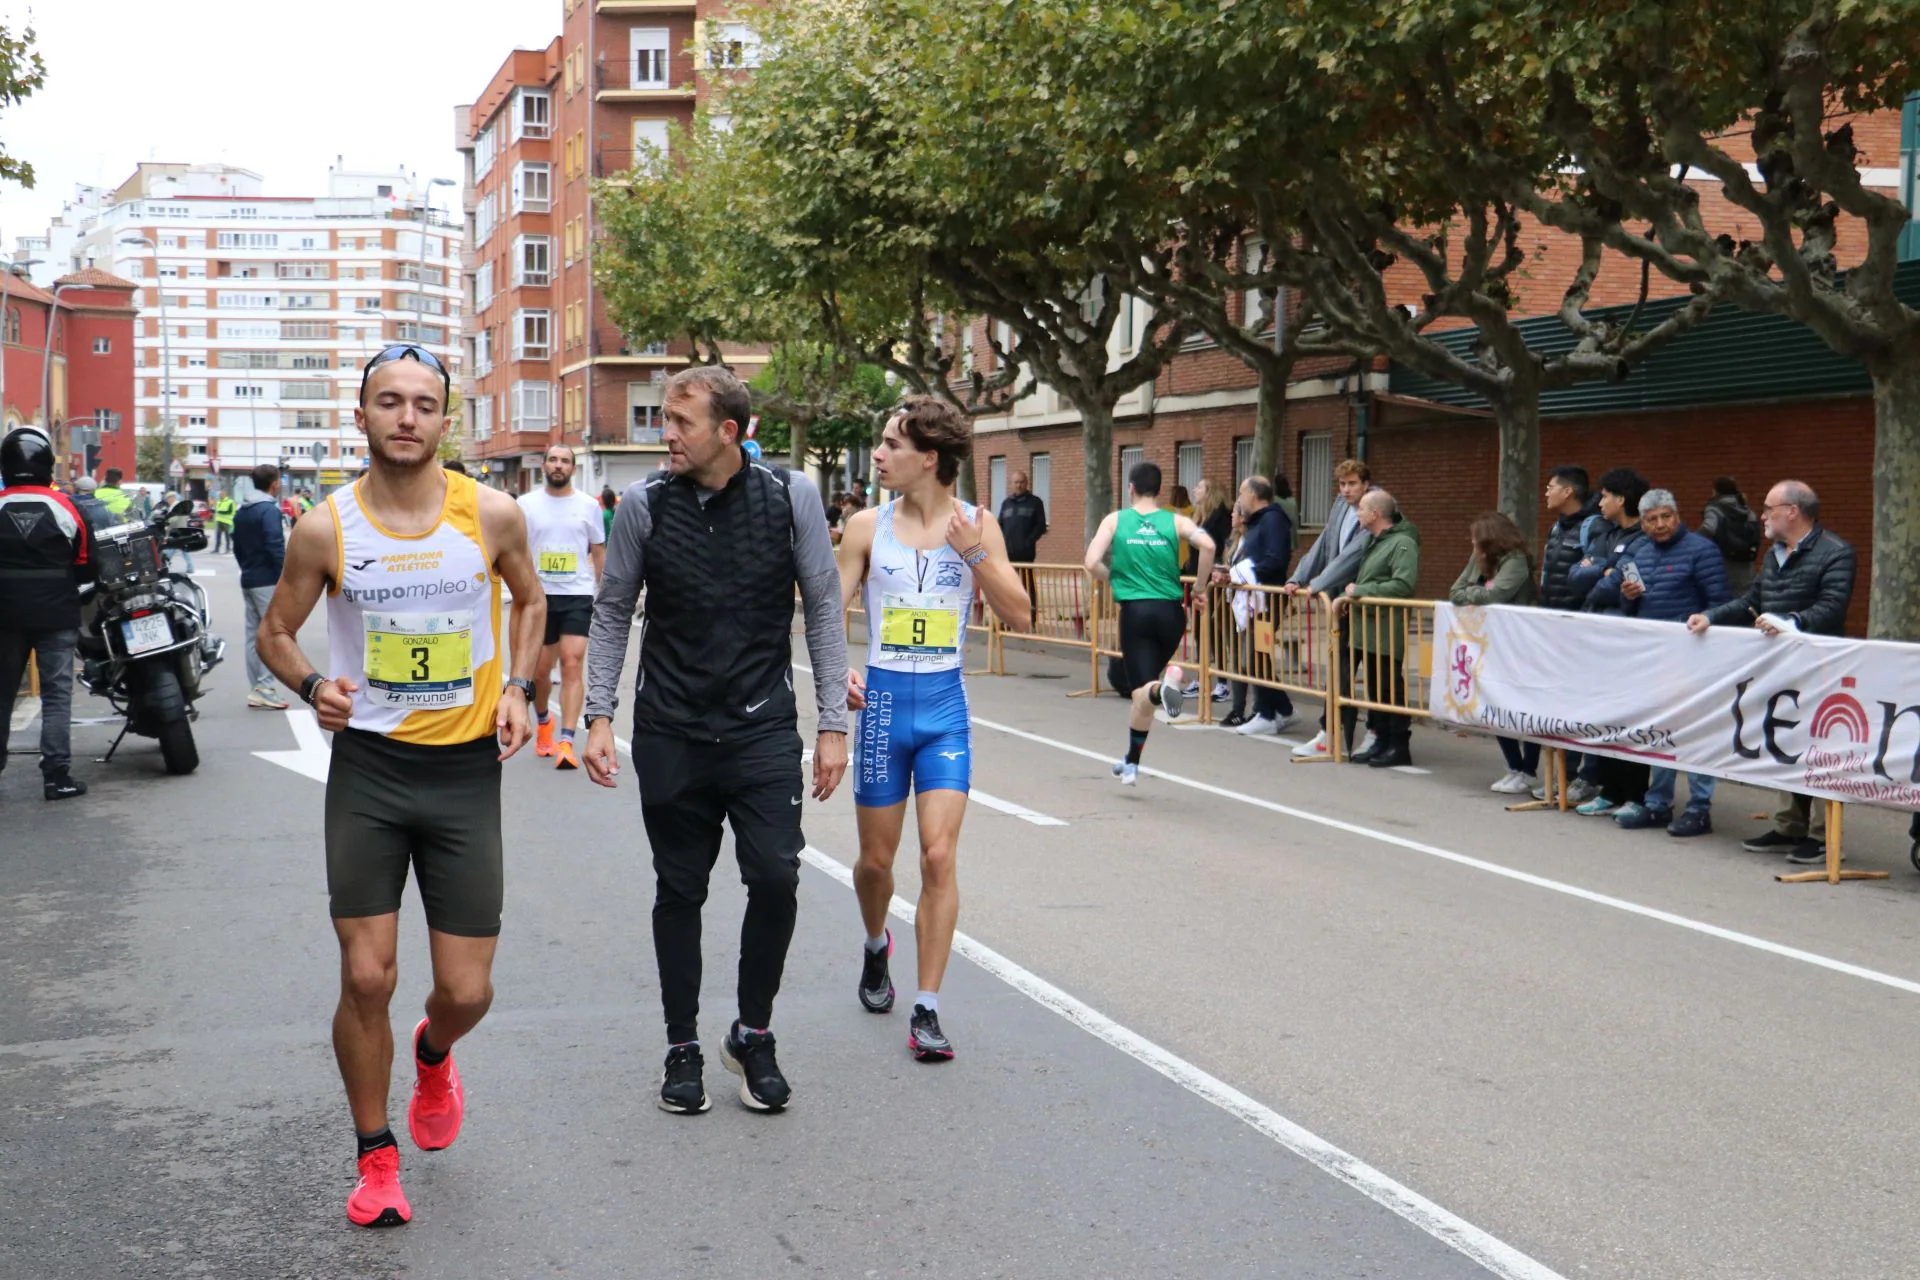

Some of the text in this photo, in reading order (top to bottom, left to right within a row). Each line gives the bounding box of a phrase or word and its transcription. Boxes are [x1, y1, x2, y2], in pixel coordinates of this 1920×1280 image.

[381, 551, 443, 564] PAMPLONA
[547, 557, 567, 571] 147
[343, 579, 467, 603] grupompleo
[402, 637, 439, 645] GONZALO
[912, 618, 926, 645] 9
[411, 647, 429, 681] 3
[406, 691, 457, 703] HYUNDAI
[1480, 703, 1602, 738] AYUNTAMIENTO
[864, 690, 878, 784] GRANOLLERS
[875, 691, 893, 783] CLUB ATLÈTIC
[1804, 744, 1868, 774] Cuna del
